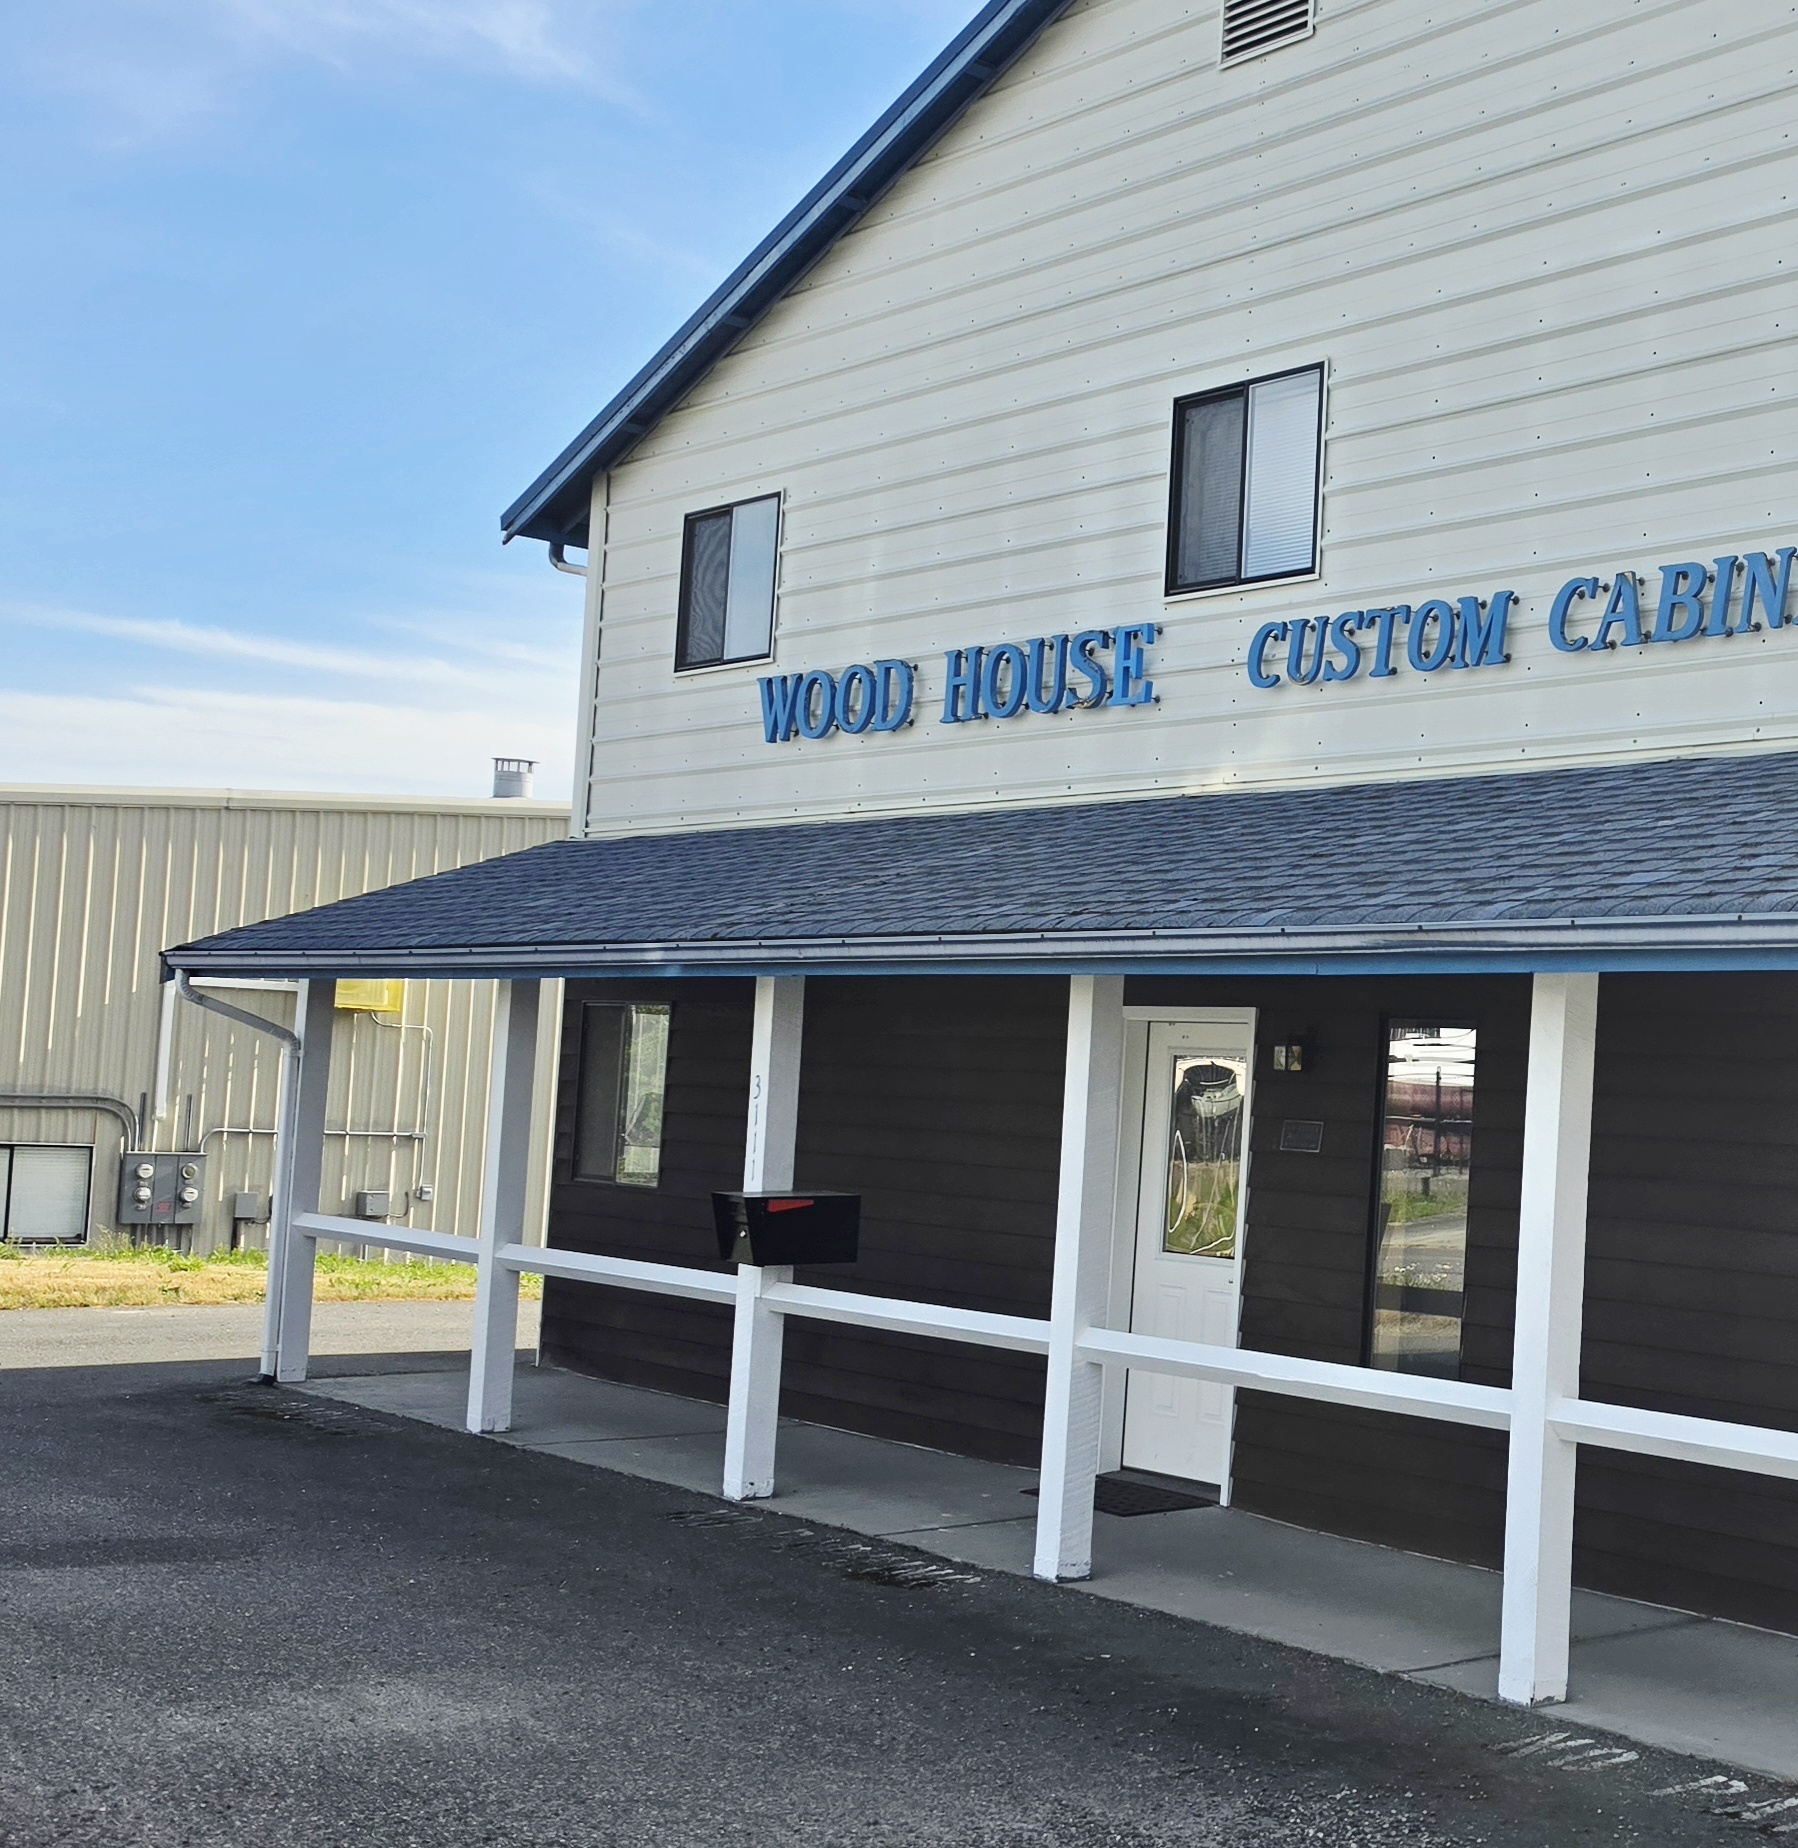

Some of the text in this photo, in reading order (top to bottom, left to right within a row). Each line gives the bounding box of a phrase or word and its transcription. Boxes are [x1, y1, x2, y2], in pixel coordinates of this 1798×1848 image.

[757, 658, 914, 743] WOOD
[940, 622, 1156, 724] HOUSE
[1247, 588, 1516, 689] CUSTOM
[750, 1074, 762, 1181] 3111
